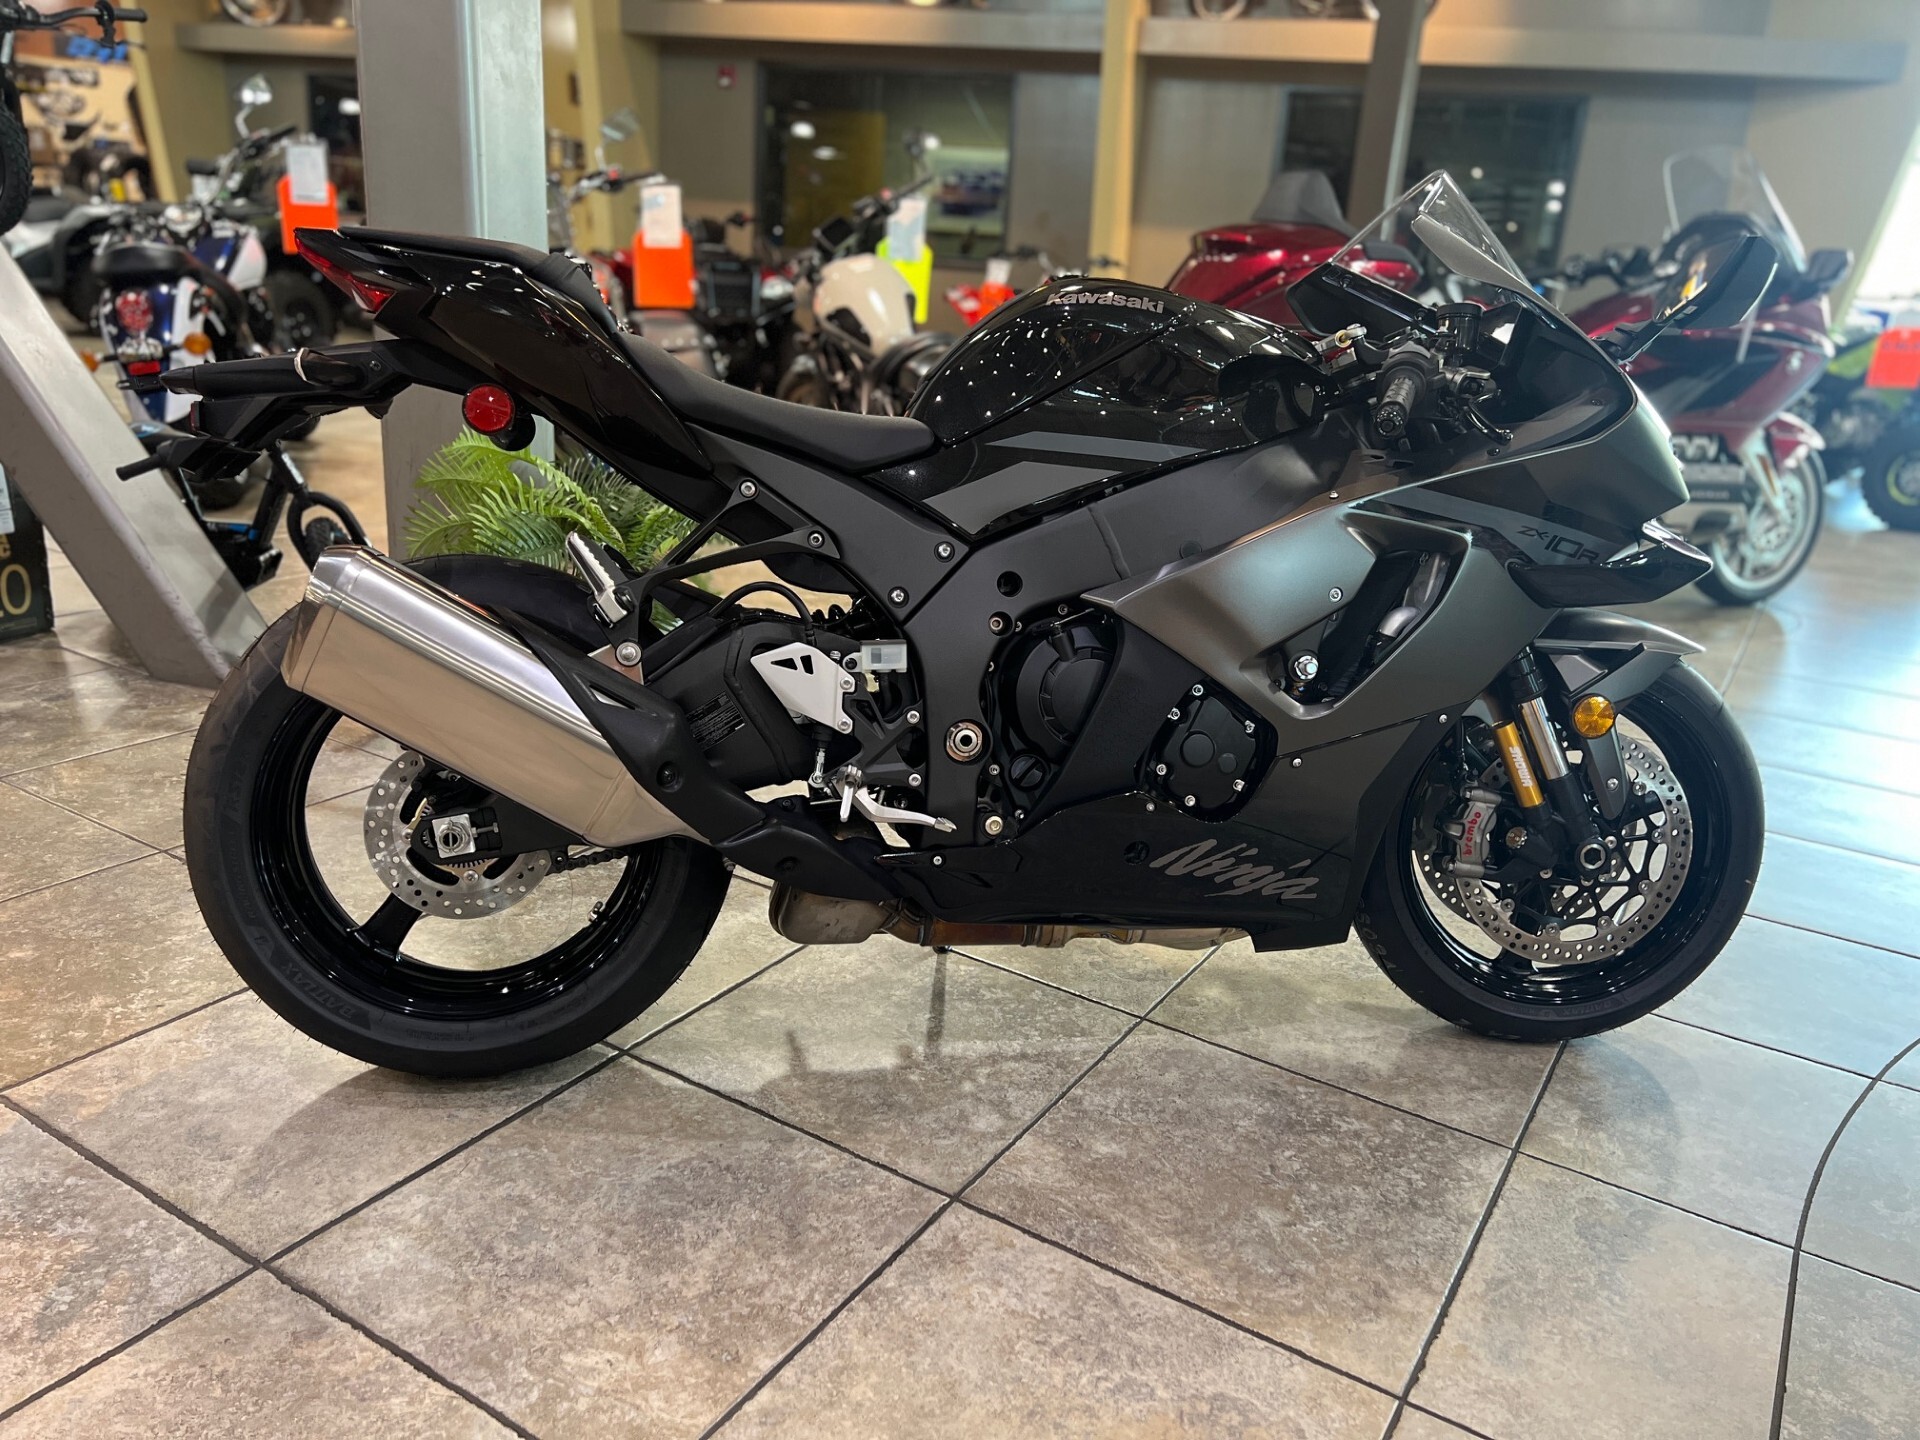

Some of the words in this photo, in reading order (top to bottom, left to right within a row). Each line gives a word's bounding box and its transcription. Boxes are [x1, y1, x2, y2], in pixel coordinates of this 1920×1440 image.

[1045, 290, 1164, 314] Kawasaki
[1516, 525, 1600, 564] ZX-10R
[0, 564, 32, 617] 0
[1463, 811, 1482, 857] brembo
[1149, 838, 1319, 900] Ninja
